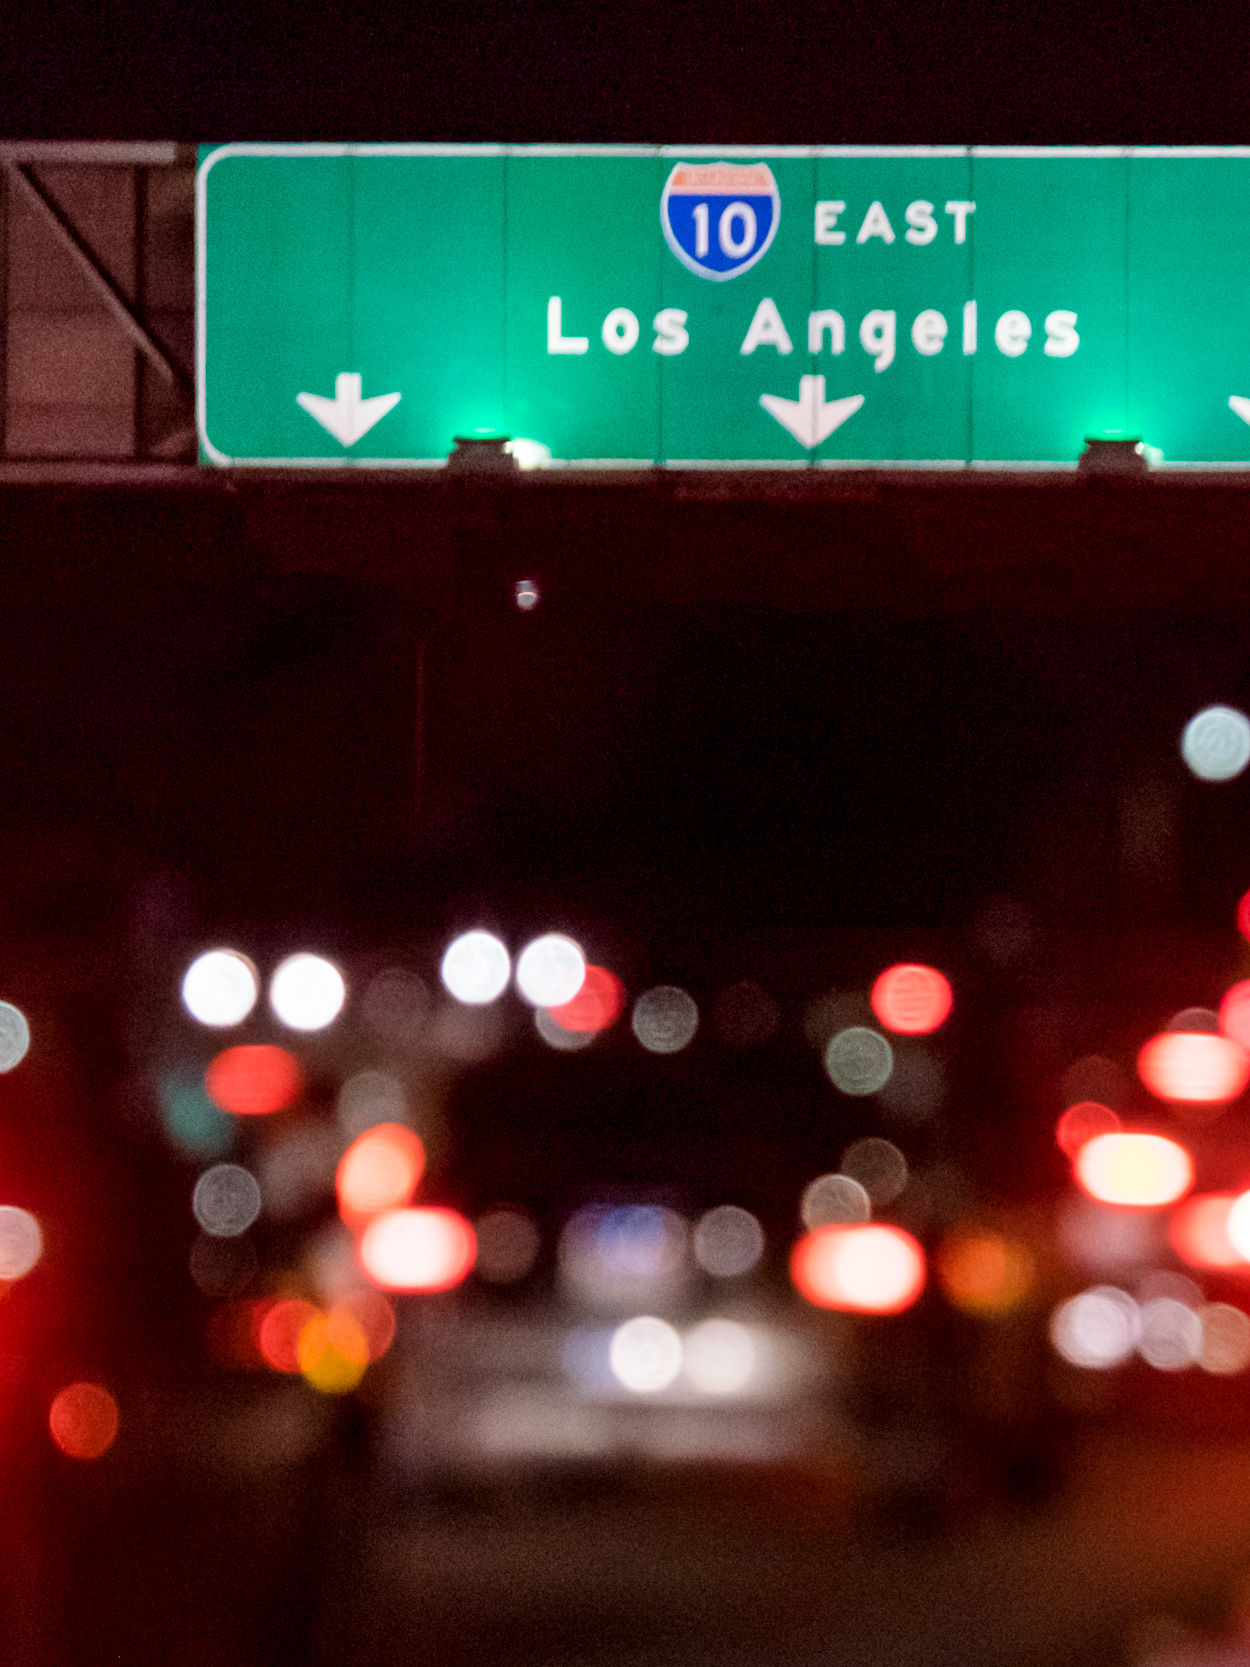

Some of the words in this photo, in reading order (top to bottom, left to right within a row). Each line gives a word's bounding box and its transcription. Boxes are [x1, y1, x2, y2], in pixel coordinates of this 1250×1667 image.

[692, 201, 757, 259] 10
[814, 200, 976, 245] EAST
[547, 296, 690, 355] Los
[740, 297, 1080, 373] Angeles
